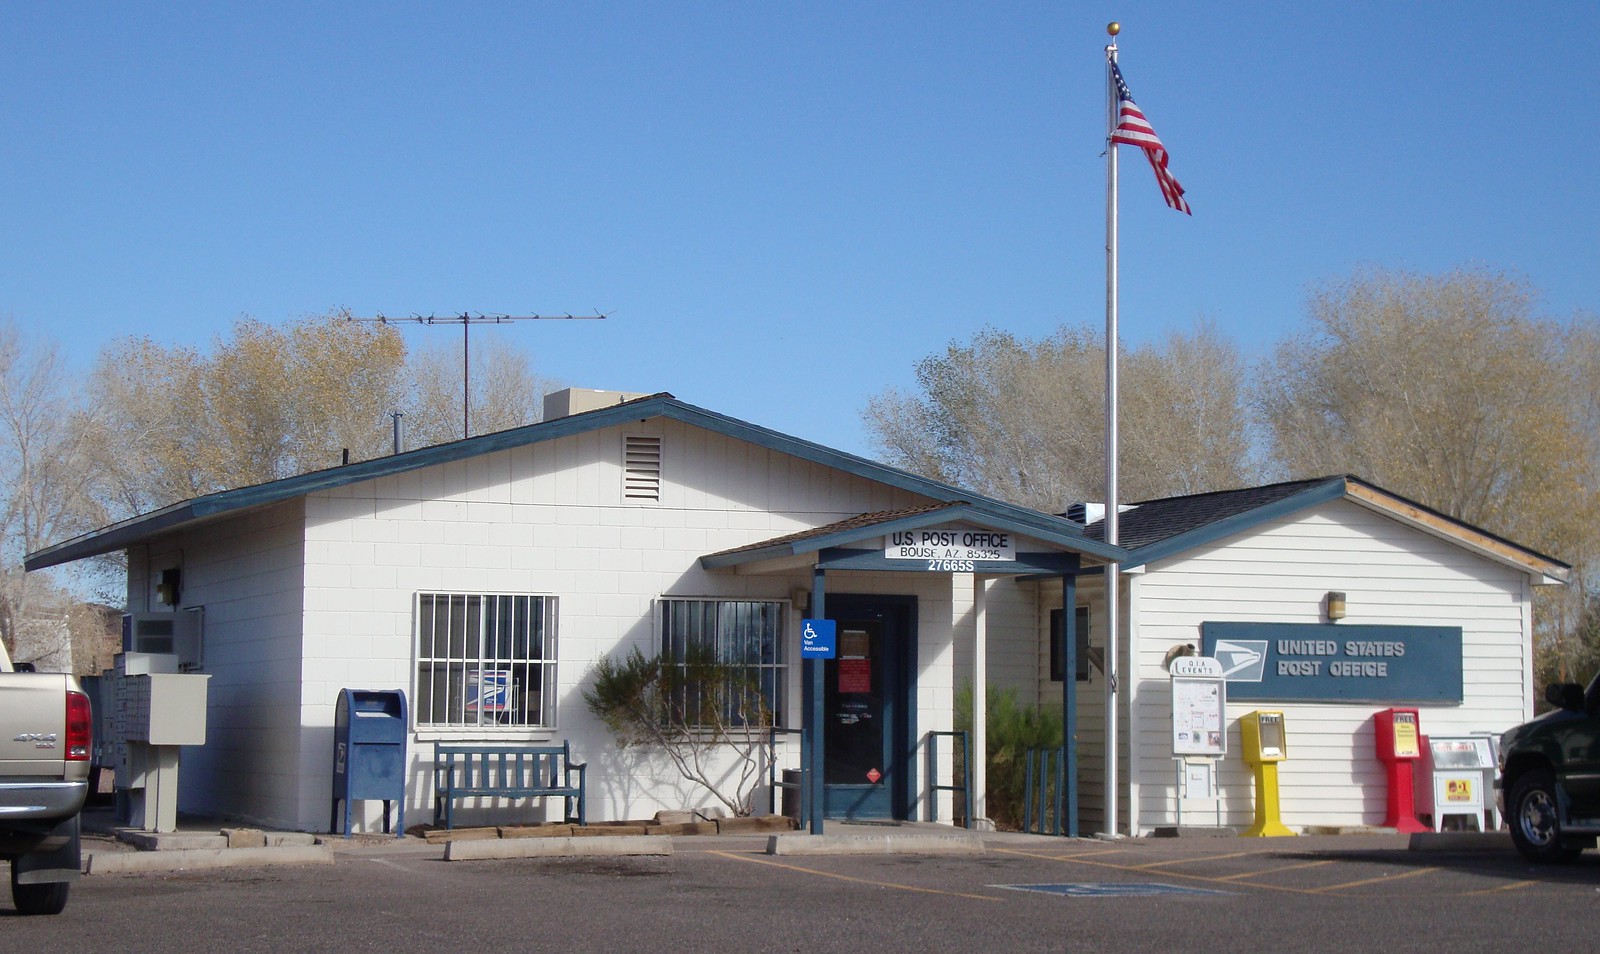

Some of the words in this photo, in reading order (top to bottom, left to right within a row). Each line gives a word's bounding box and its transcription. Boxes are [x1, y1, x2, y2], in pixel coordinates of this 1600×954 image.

[892, 531, 917, 546] U.S.
[922, 532, 957, 547] POST
[963, 532, 1008, 548] OFFICE
[967, 549, 1001, 559] 85325
[928, 560, 974, 571] 27665S
[1277, 639, 1337, 656] UNITED
[1345, 640, 1405, 657] STATES
[1277, 660, 1322, 676] POST
[1329, 661, 1388, 677] OFFICE
